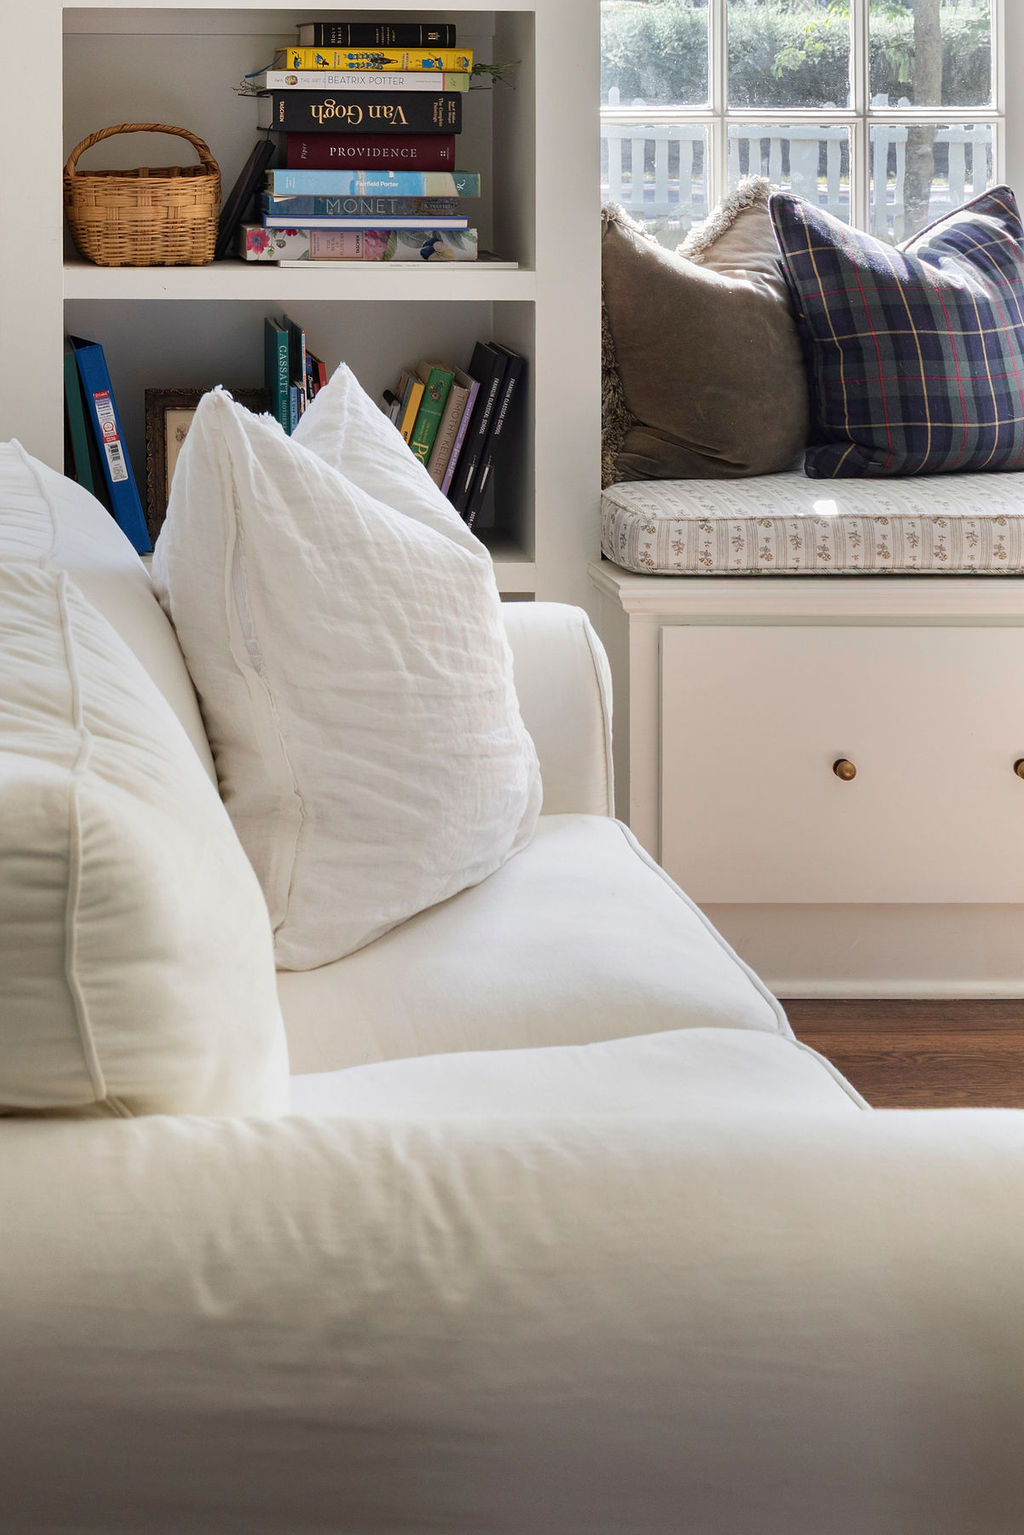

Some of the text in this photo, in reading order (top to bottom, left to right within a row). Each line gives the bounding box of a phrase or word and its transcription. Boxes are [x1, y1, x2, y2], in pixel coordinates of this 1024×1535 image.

[327, 76, 366, 85] BEATRIX
[369, 76, 405, 86] POTTER
[310, 98, 409, 125] Van Gogh
[329, 147, 417, 158] PROVIDENCE
[327, 199, 398, 213] MONET
[279, 345, 288, 395] CASSATT
[446, 393, 465, 437] TIMOTHY
[434, 440, 448, 474] KELLER
